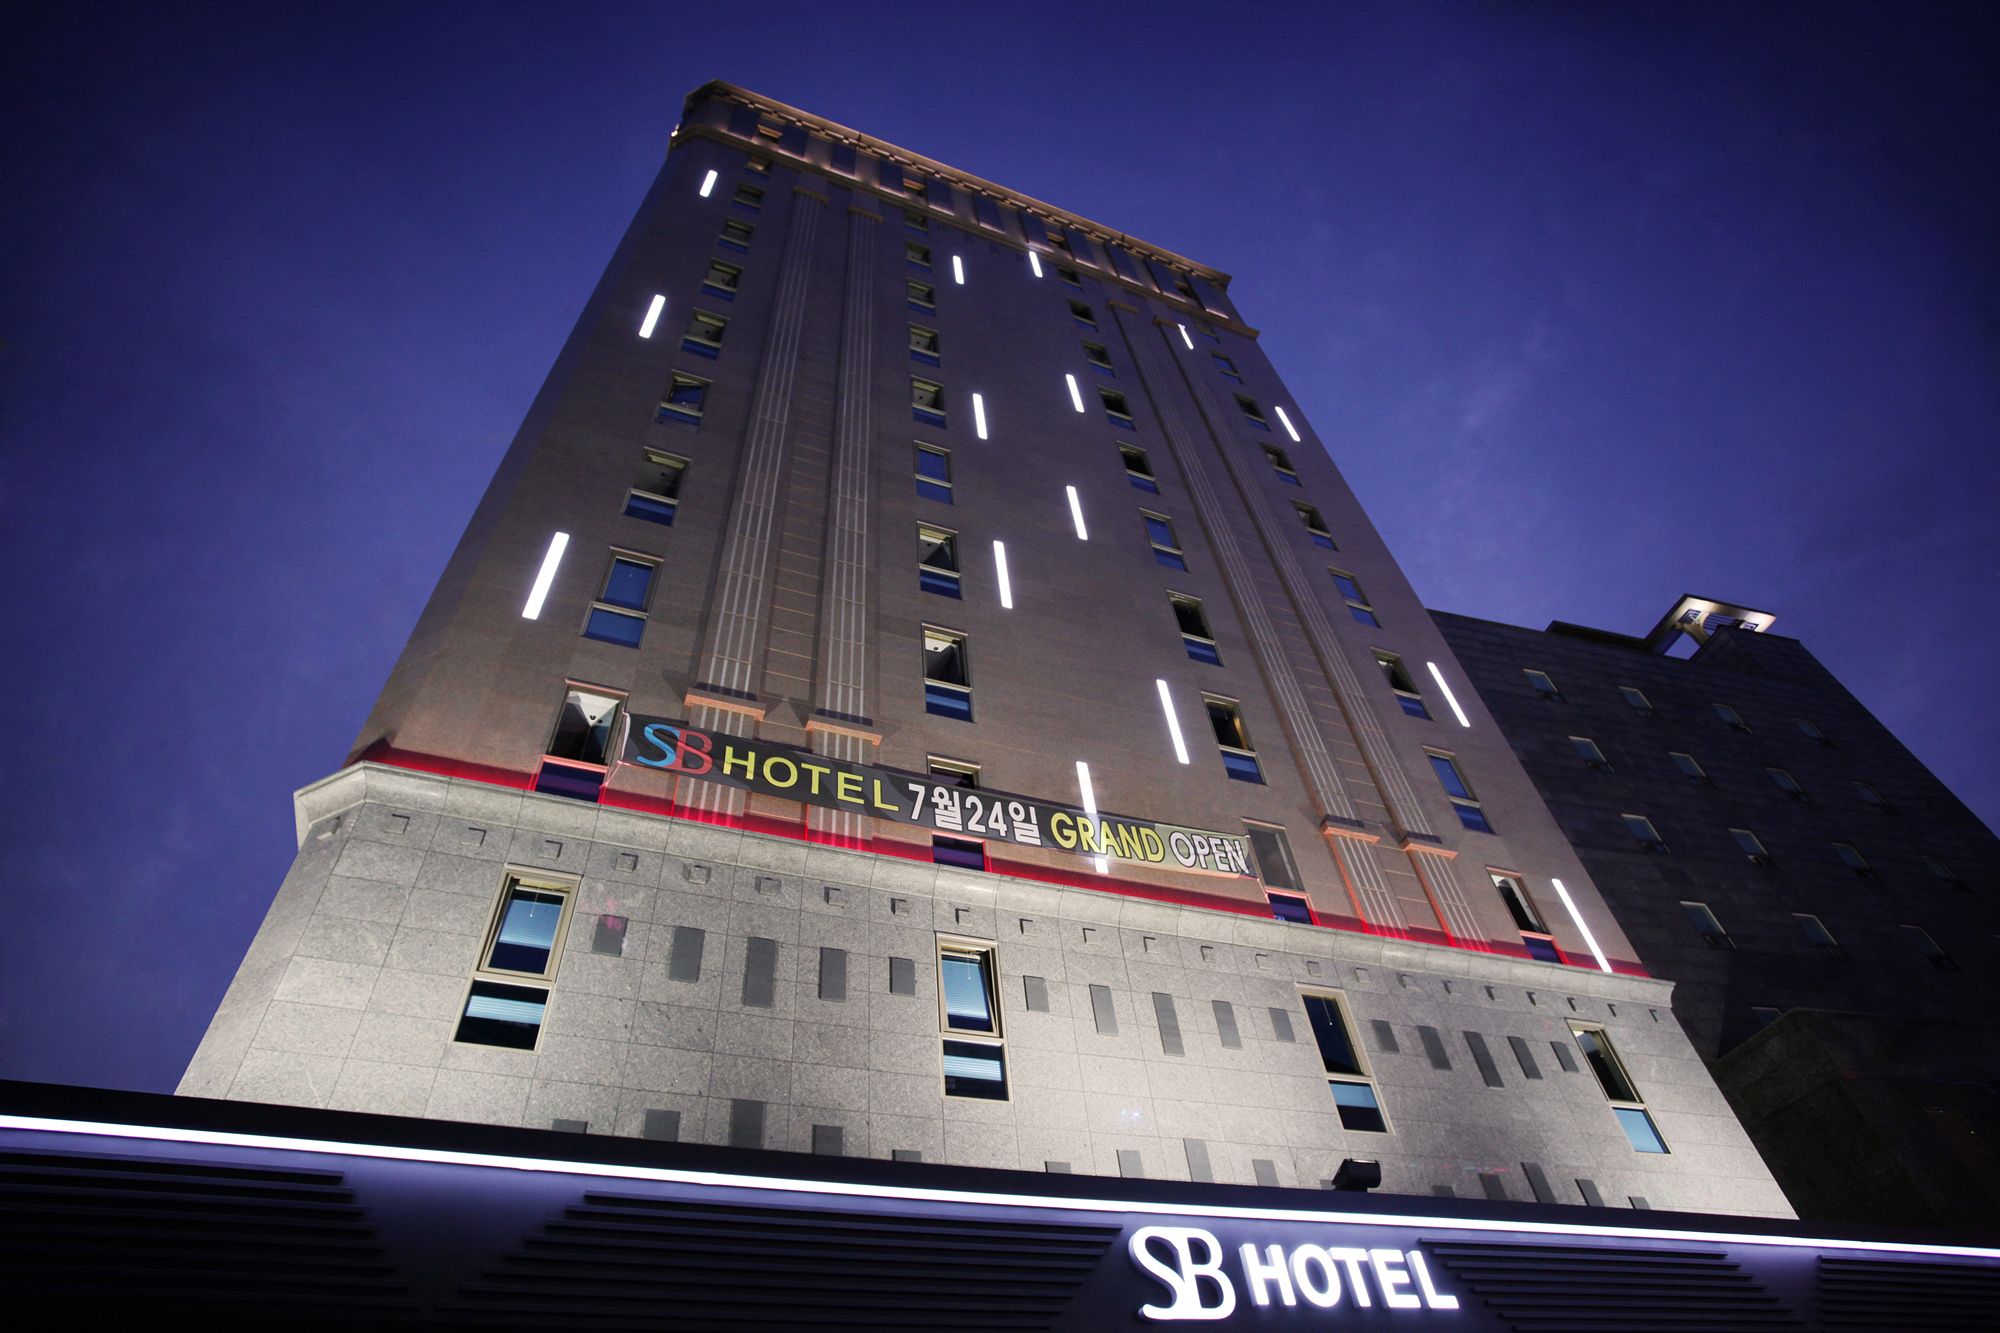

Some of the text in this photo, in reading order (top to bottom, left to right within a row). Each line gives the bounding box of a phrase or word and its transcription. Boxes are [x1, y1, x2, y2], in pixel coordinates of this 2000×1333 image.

[636, 723, 713, 775] SB
[722, 745, 899, 812] HOTEL
[1050, 812, 1166, 863] GRAND
[1169, 831, 1250, 874] OPEN
[1128, 1225, 1460, 1320] SB HOTEL
